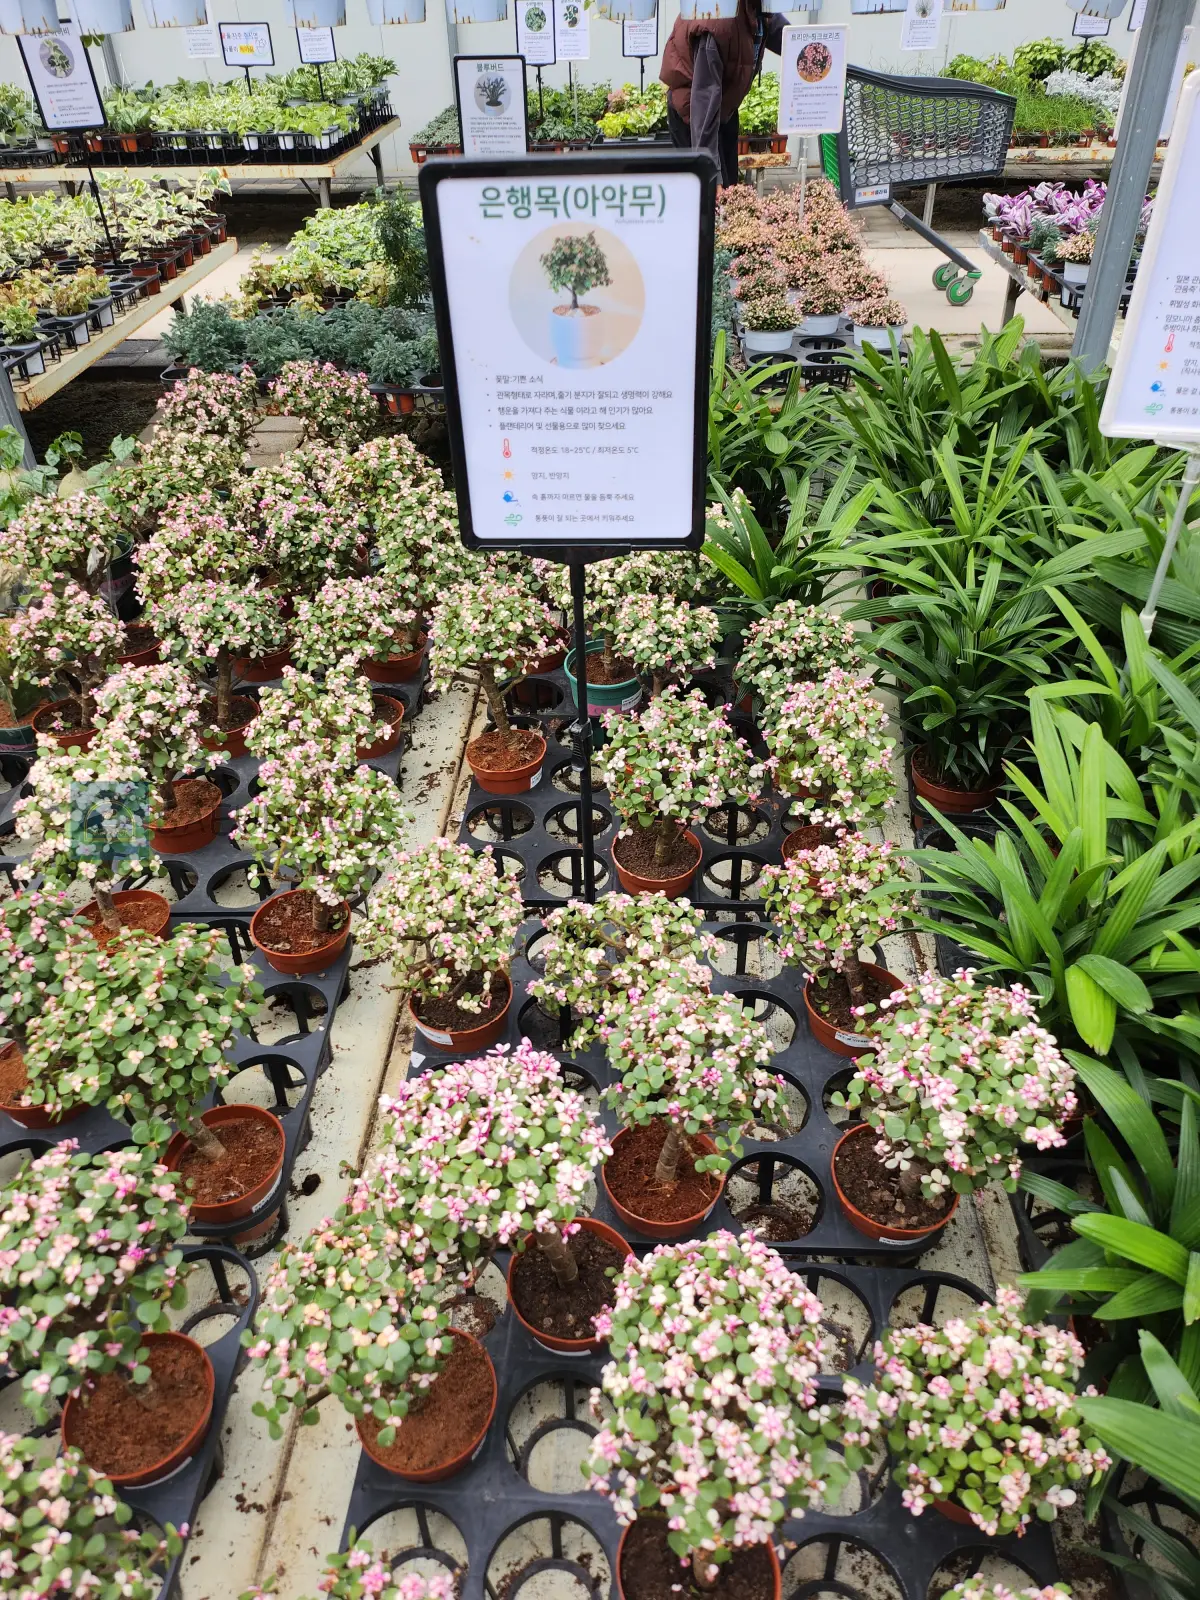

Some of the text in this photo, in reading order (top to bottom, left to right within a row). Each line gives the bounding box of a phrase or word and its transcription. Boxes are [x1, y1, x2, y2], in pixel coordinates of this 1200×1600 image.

[478, 184, 666, 219] 은행목(아악무)
[495, 374, 544, 384] 꽃말:기쁜 소식
[496, 391, 532, 400] 관목형태로
[574, 391, 596, 400] 분지가
[598, 391, 619, 400] 잘되고
[621, 390, 649, 400] 생명력이
[651, 390, 673, 400] 강해요
[497, 406, 653, 416] 행운을 가져다 주는 식물 이라고 해 인기가 많아요
[499, 421, 626, 431] 플랜테리어 및 선물용으로 많이 찾으세요
[531, 446, 559, 455] 적정온도
[597, 446, 626, 455] 최저온도
[531, 471, 570, 481] 양지, 반양지
[562, 493, 582, 501] 마르면
[584, 493, 597, 501] 물을
[599, 493, 613, 501] 듬뿍
[614, 493, 635, 501] 주세요
[535, 514, 635, 523] 통풍이 잘 되는 곳에서 키워주세요
